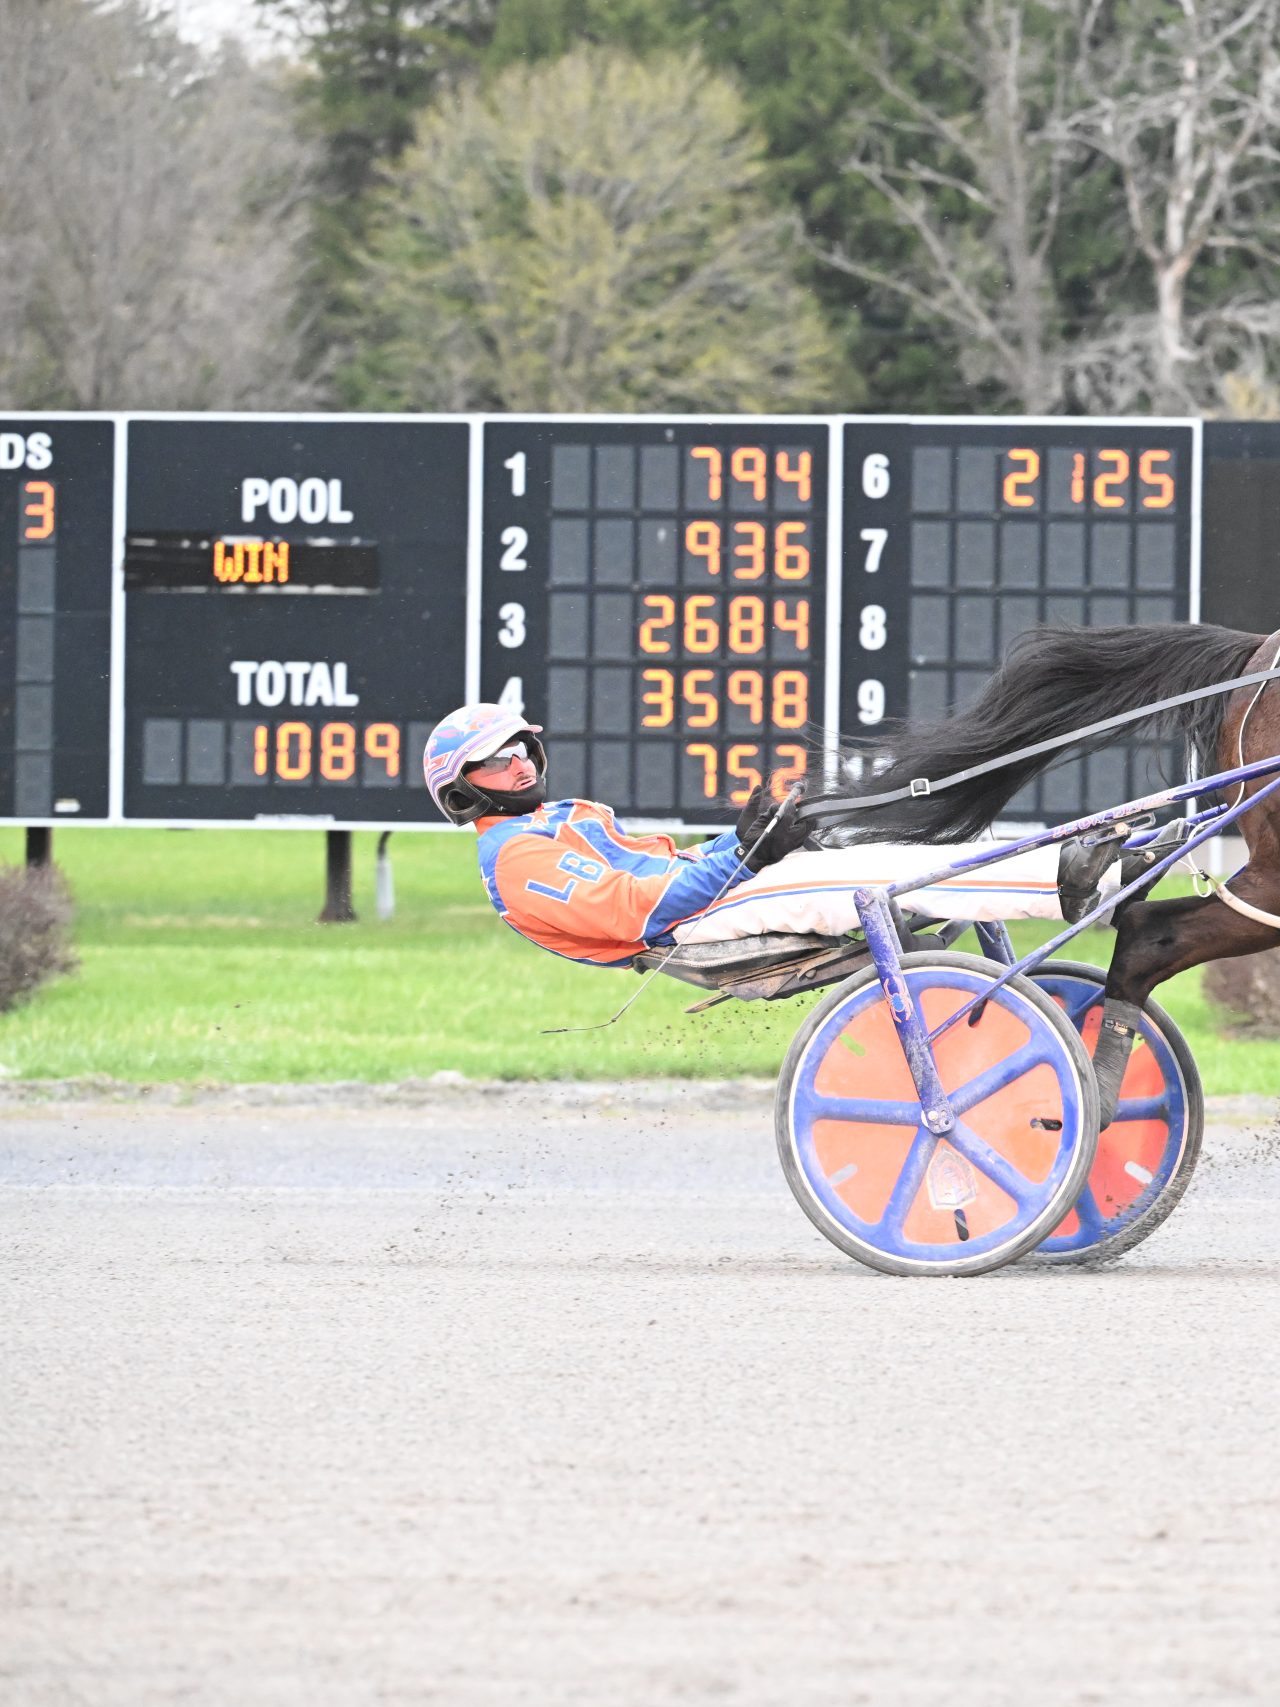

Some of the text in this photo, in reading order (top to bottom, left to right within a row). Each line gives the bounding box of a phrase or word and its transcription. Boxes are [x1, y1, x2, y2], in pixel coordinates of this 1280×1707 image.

[504, 452, 526, 497] 1
[691, 446, 812, 501] 794
[862, 453, 890, 499] 6
[1003, 448, 1174, 508] 2125
[25, 481, 55, 539] 3
[242, 478, 354, 523] POOL
[213, 541, 289, 583] WIN
[500, 526, 528, 571] 2
[685, 520, 810, 580] 936
[859, 528, 888, 573] 7
[498, 602, 526, 648] 3
[639, 594, 809, 654] 2684
[859, 604, 887, 651] 8
[230, 661, 359, 706] TOTAL
[497, 676, 525, 718] 4
[642, 669, 808, 729] 3598
[857, 679, 885, 725] 9
[254, 722, 400, 780] 1089
[686, 743, 807, 805] 752
